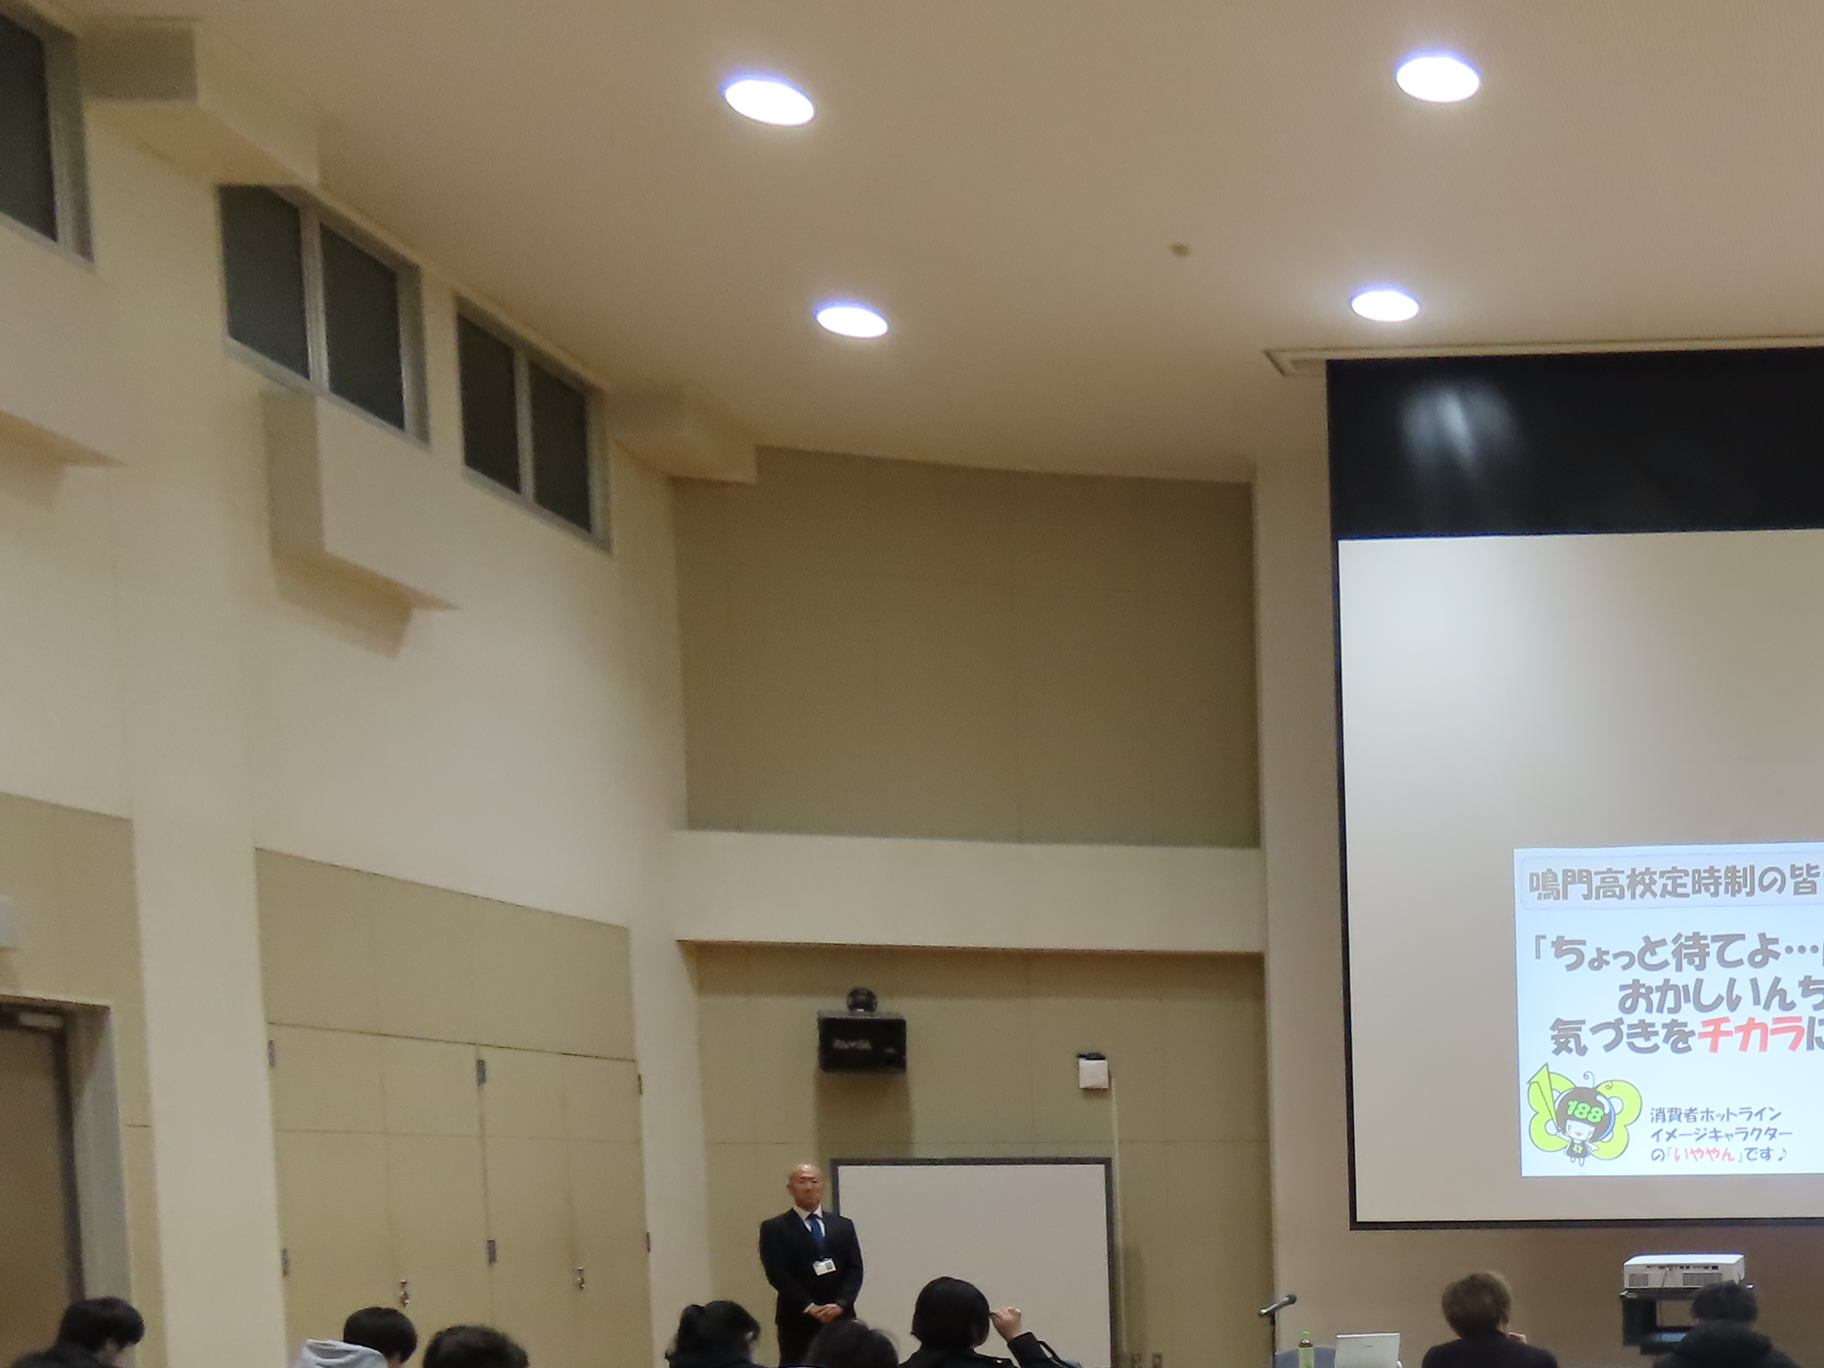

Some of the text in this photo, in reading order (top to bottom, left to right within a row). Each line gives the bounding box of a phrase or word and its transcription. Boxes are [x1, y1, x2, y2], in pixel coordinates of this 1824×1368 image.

[1566, 1100, 1604, 1123] 188
[1650, 1106, 1782, 1124] 消費者ホットライン
[1651, 1127, 1793, 1143] イメージキャラクター
